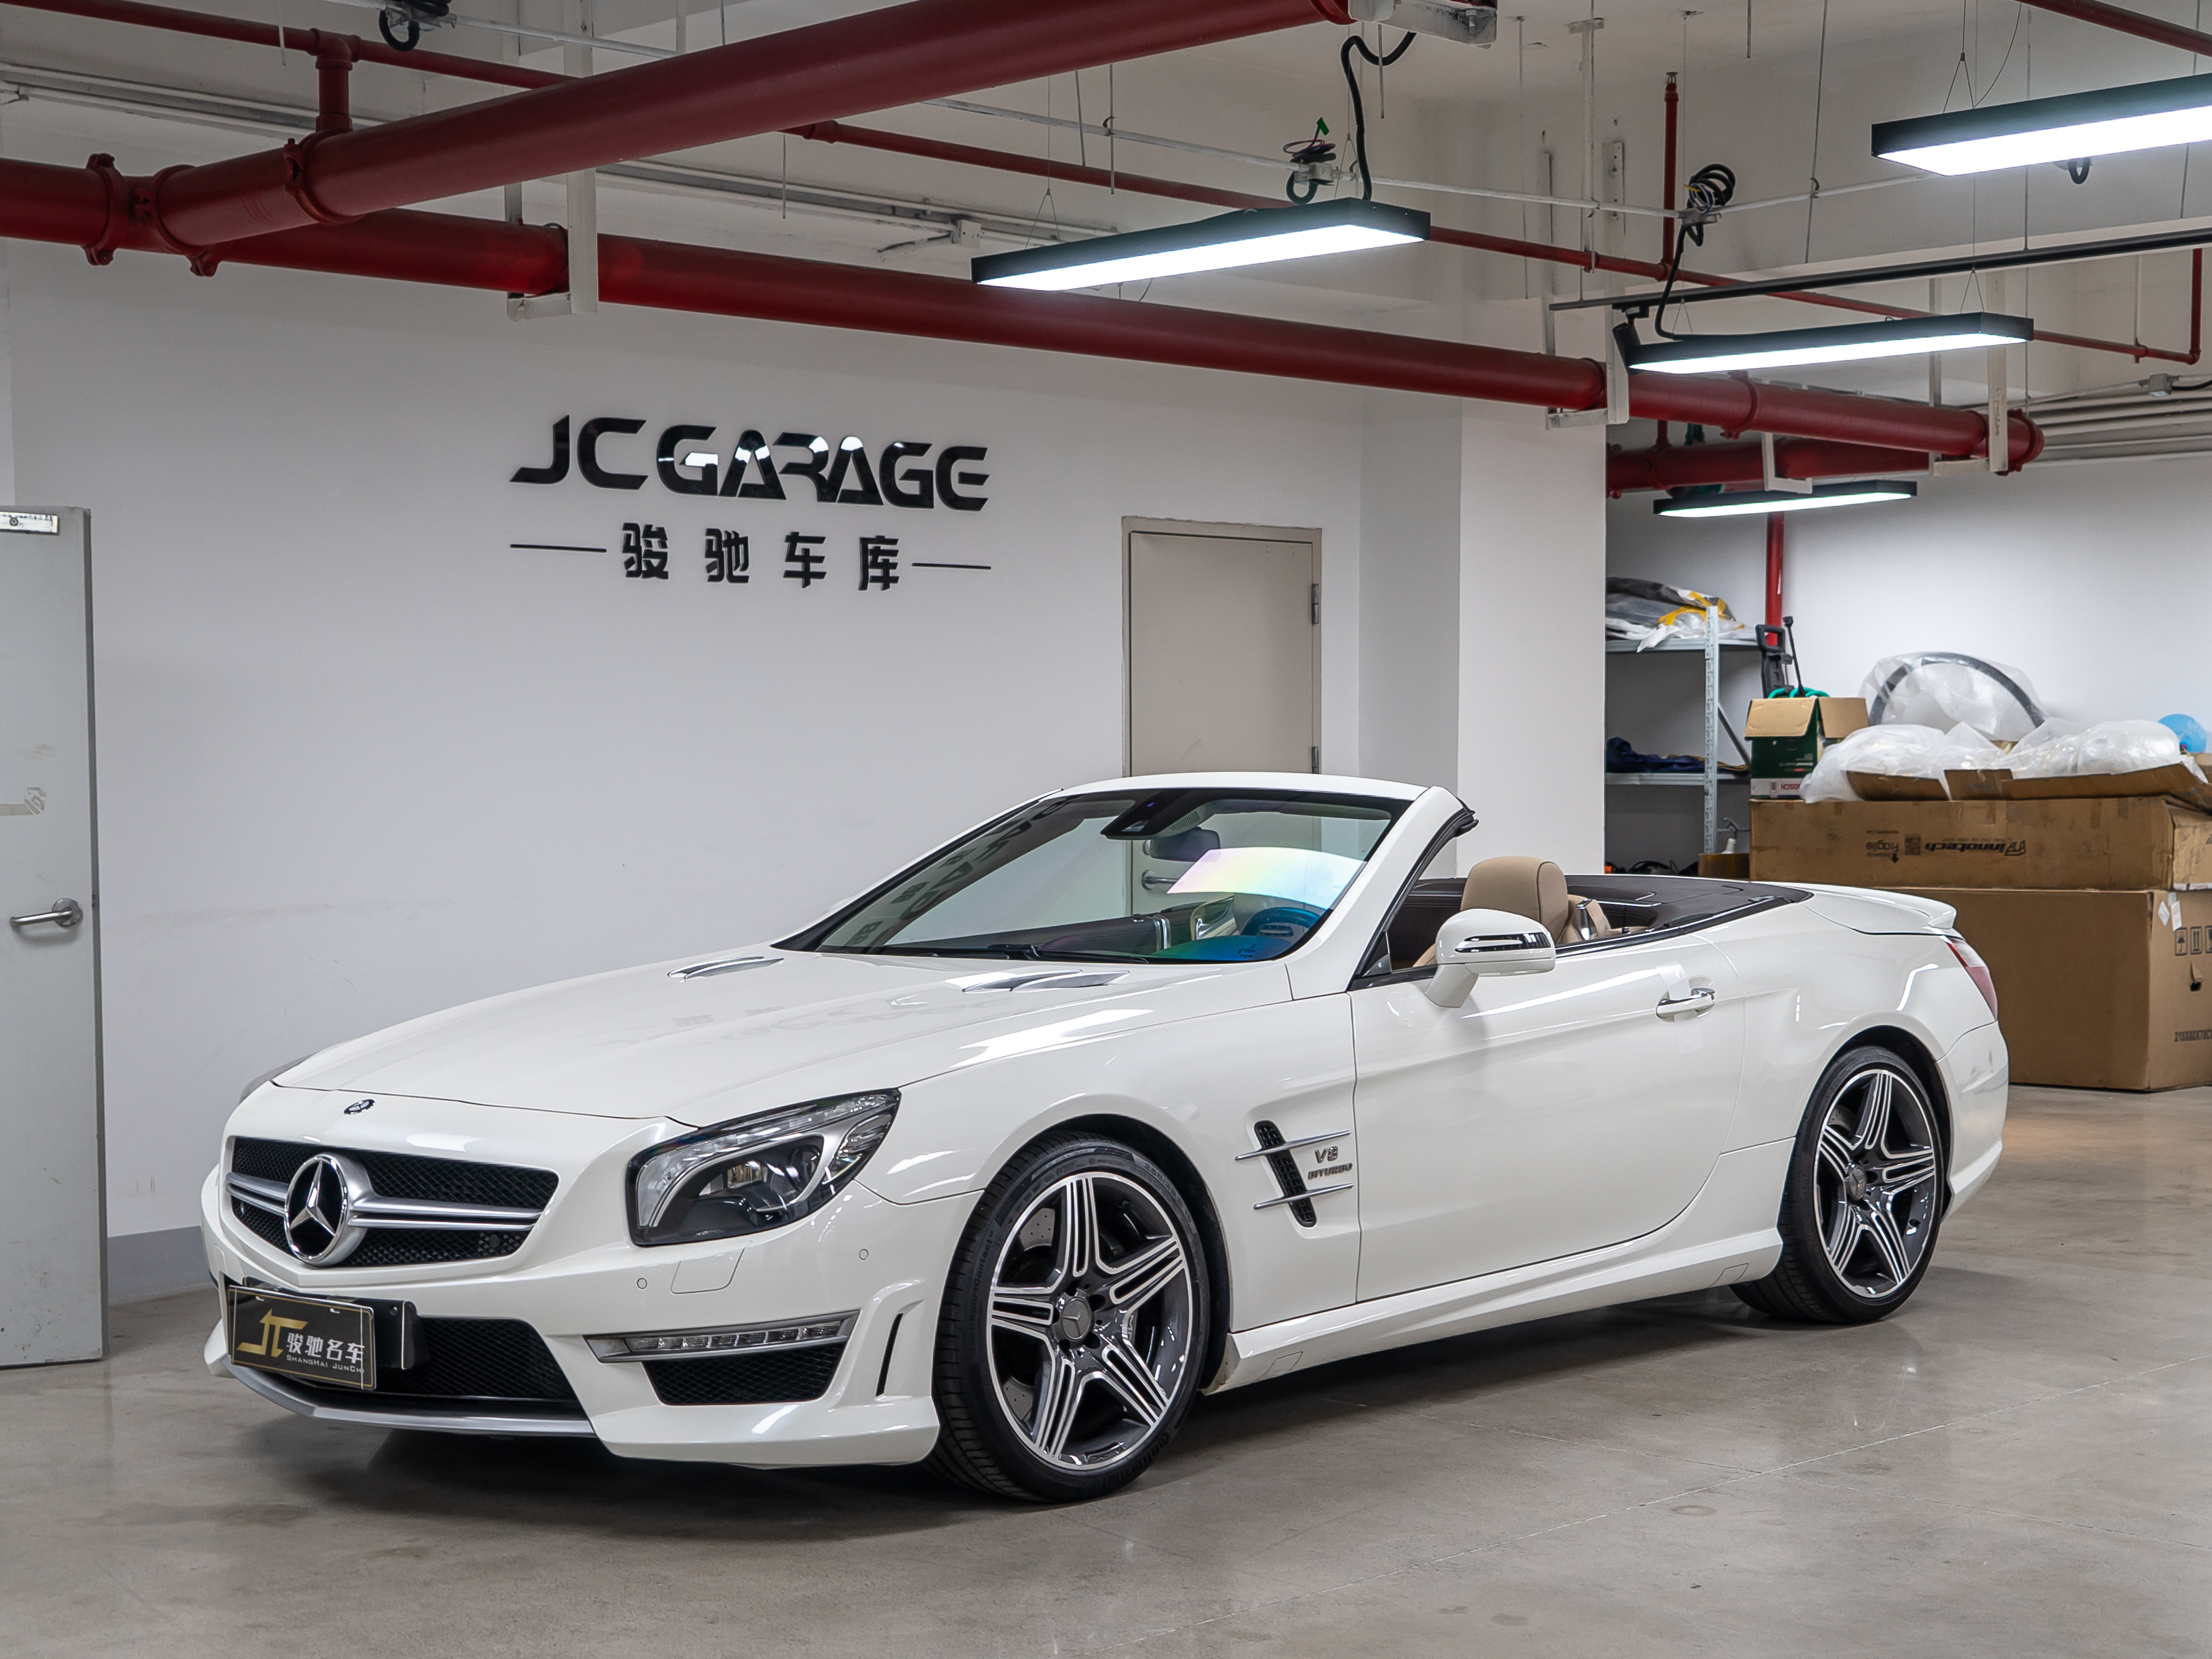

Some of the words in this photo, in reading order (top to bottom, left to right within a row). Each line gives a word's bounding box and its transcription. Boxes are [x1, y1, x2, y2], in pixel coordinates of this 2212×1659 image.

[622, 522, 900, 592] 骏驰车库
[1866, 839, 1899, 852] Fragile
[1924, 842, 2005, 853] Innotech
[1315, 1146, 1338, 1163] V8
[1308, 1163, 1353, 1180] BITURBO
[286, 1332, 365, 1363] 骏驰名车
